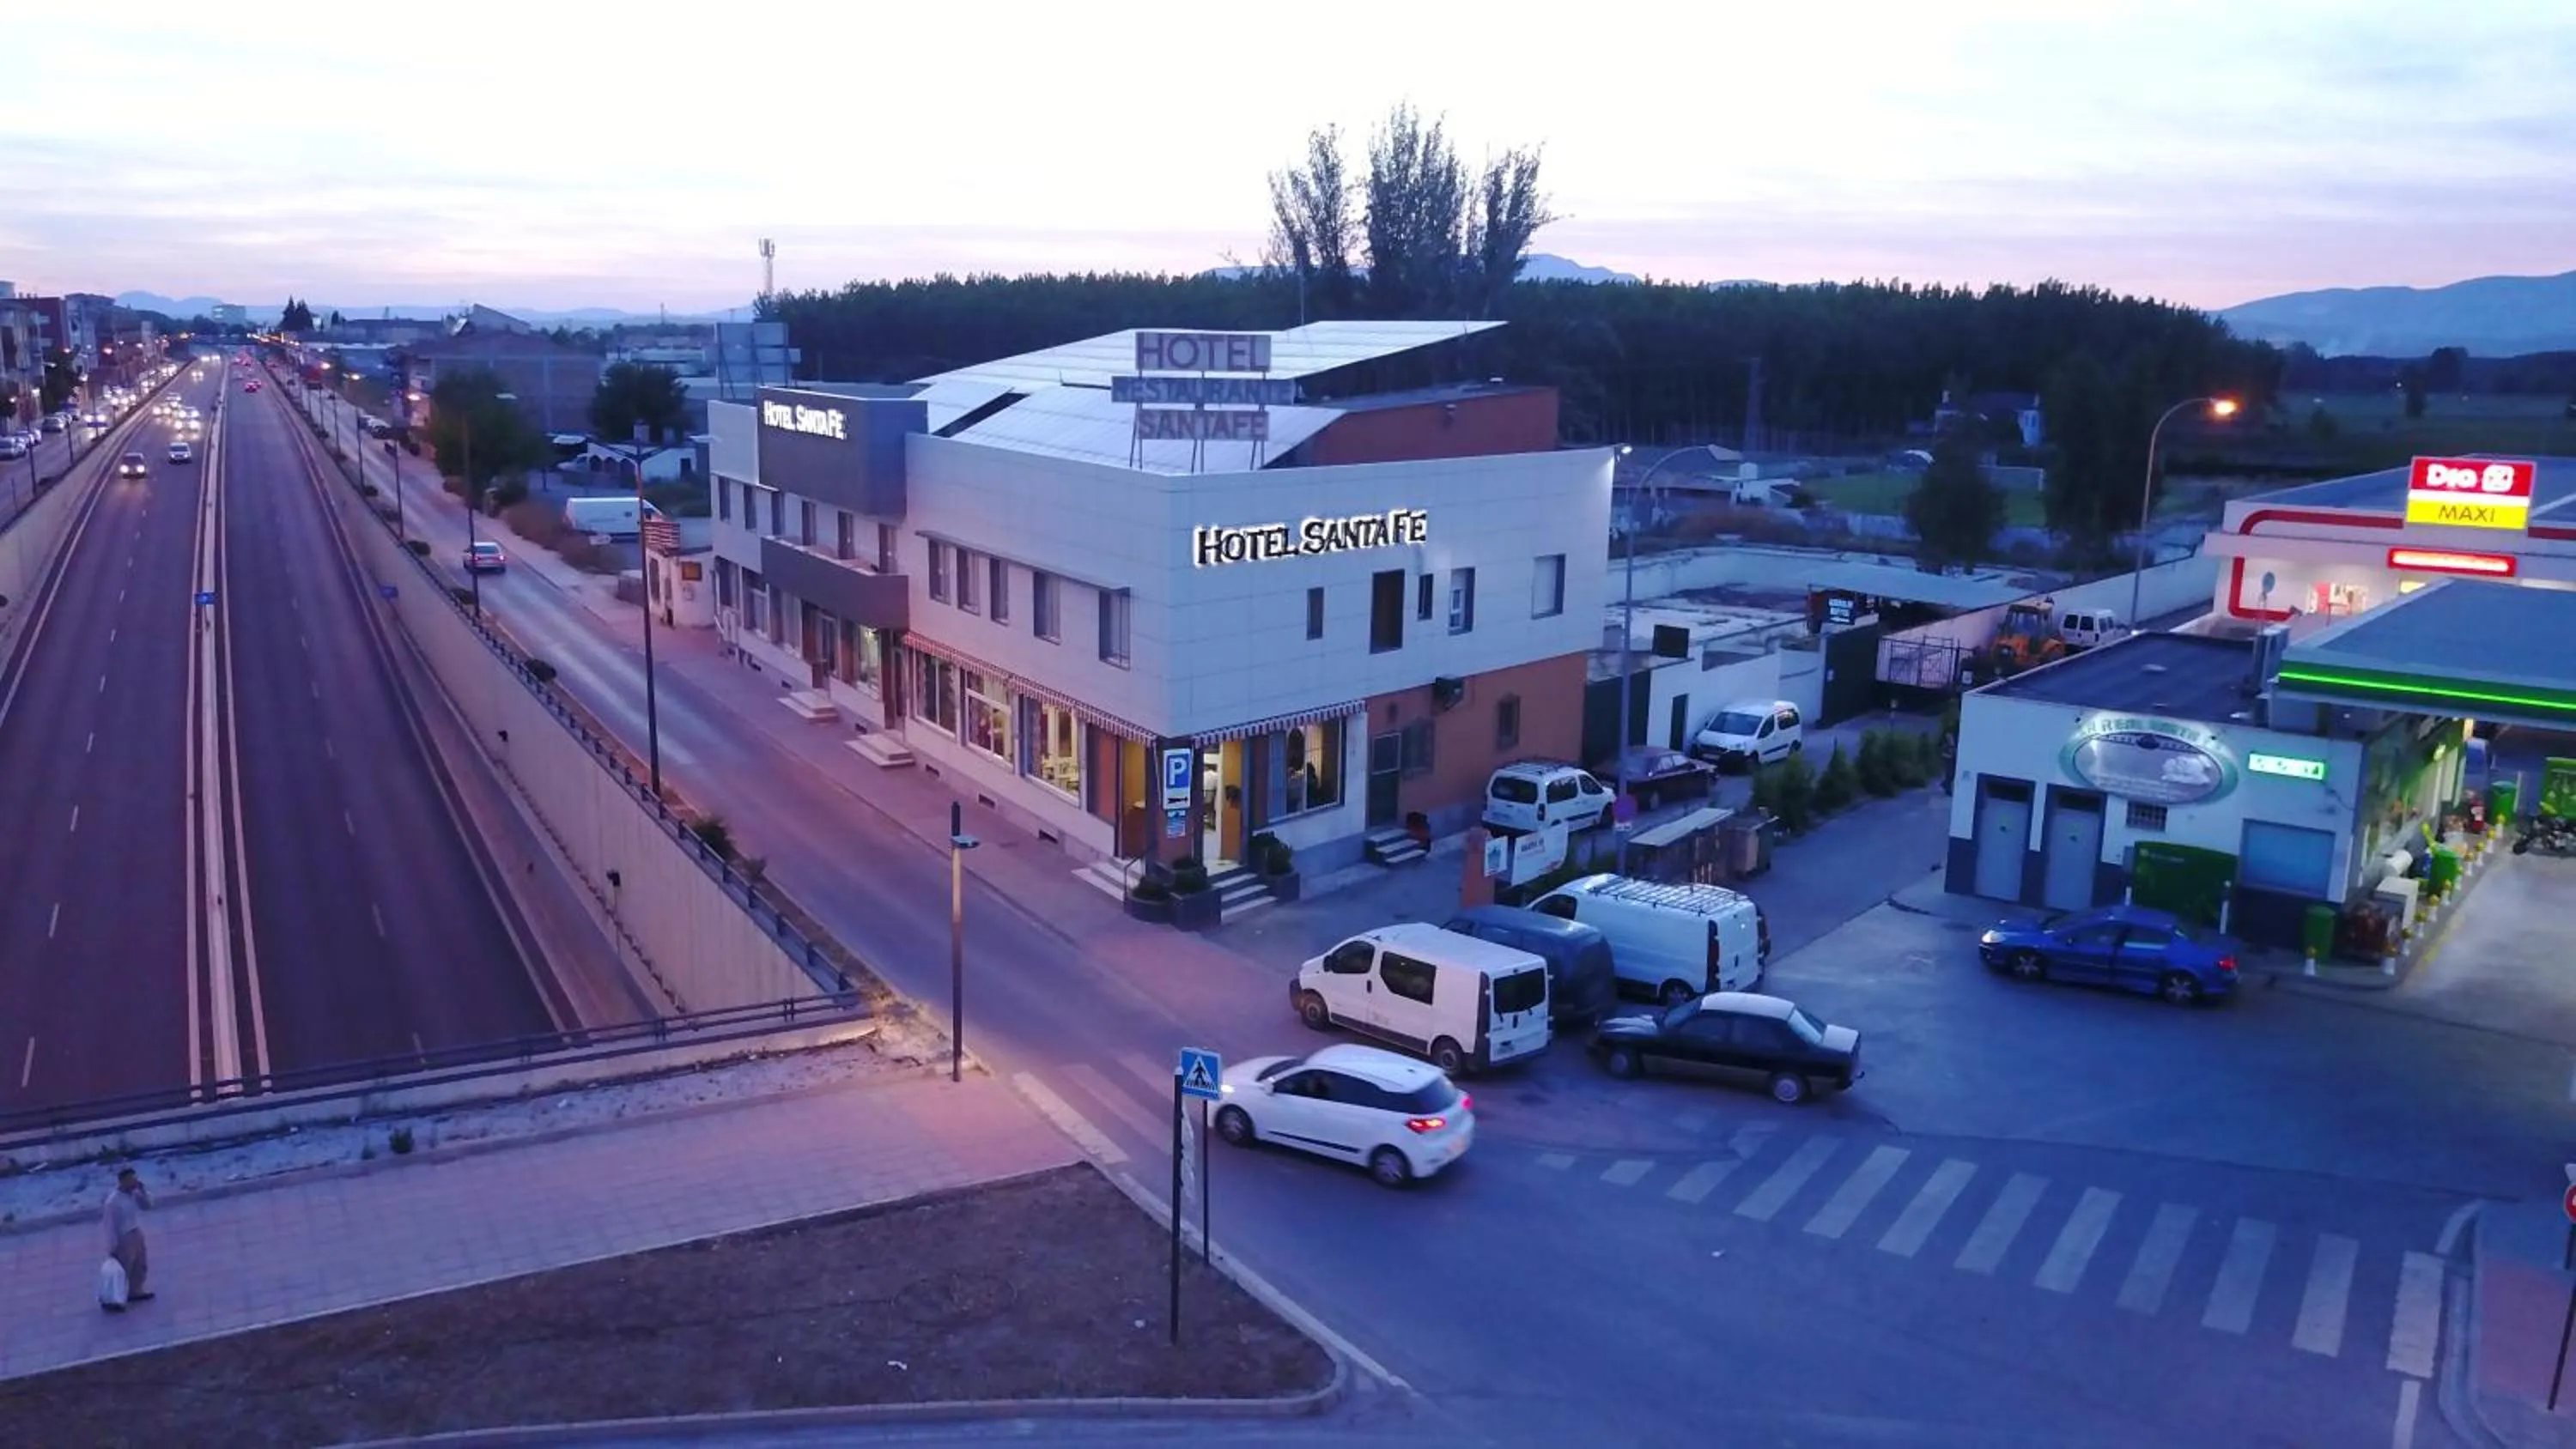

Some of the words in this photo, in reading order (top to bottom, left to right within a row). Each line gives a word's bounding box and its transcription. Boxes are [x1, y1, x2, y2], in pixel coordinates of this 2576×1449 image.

[1136, 331, 1270, 371] HOTEL
[763, 399, 796, 431] HOTEL
[2438, 505, 2496, 523] MAXI
[1194, 522, 1299, 567] HOTEL
[1169, 757, 1187, 785] P
